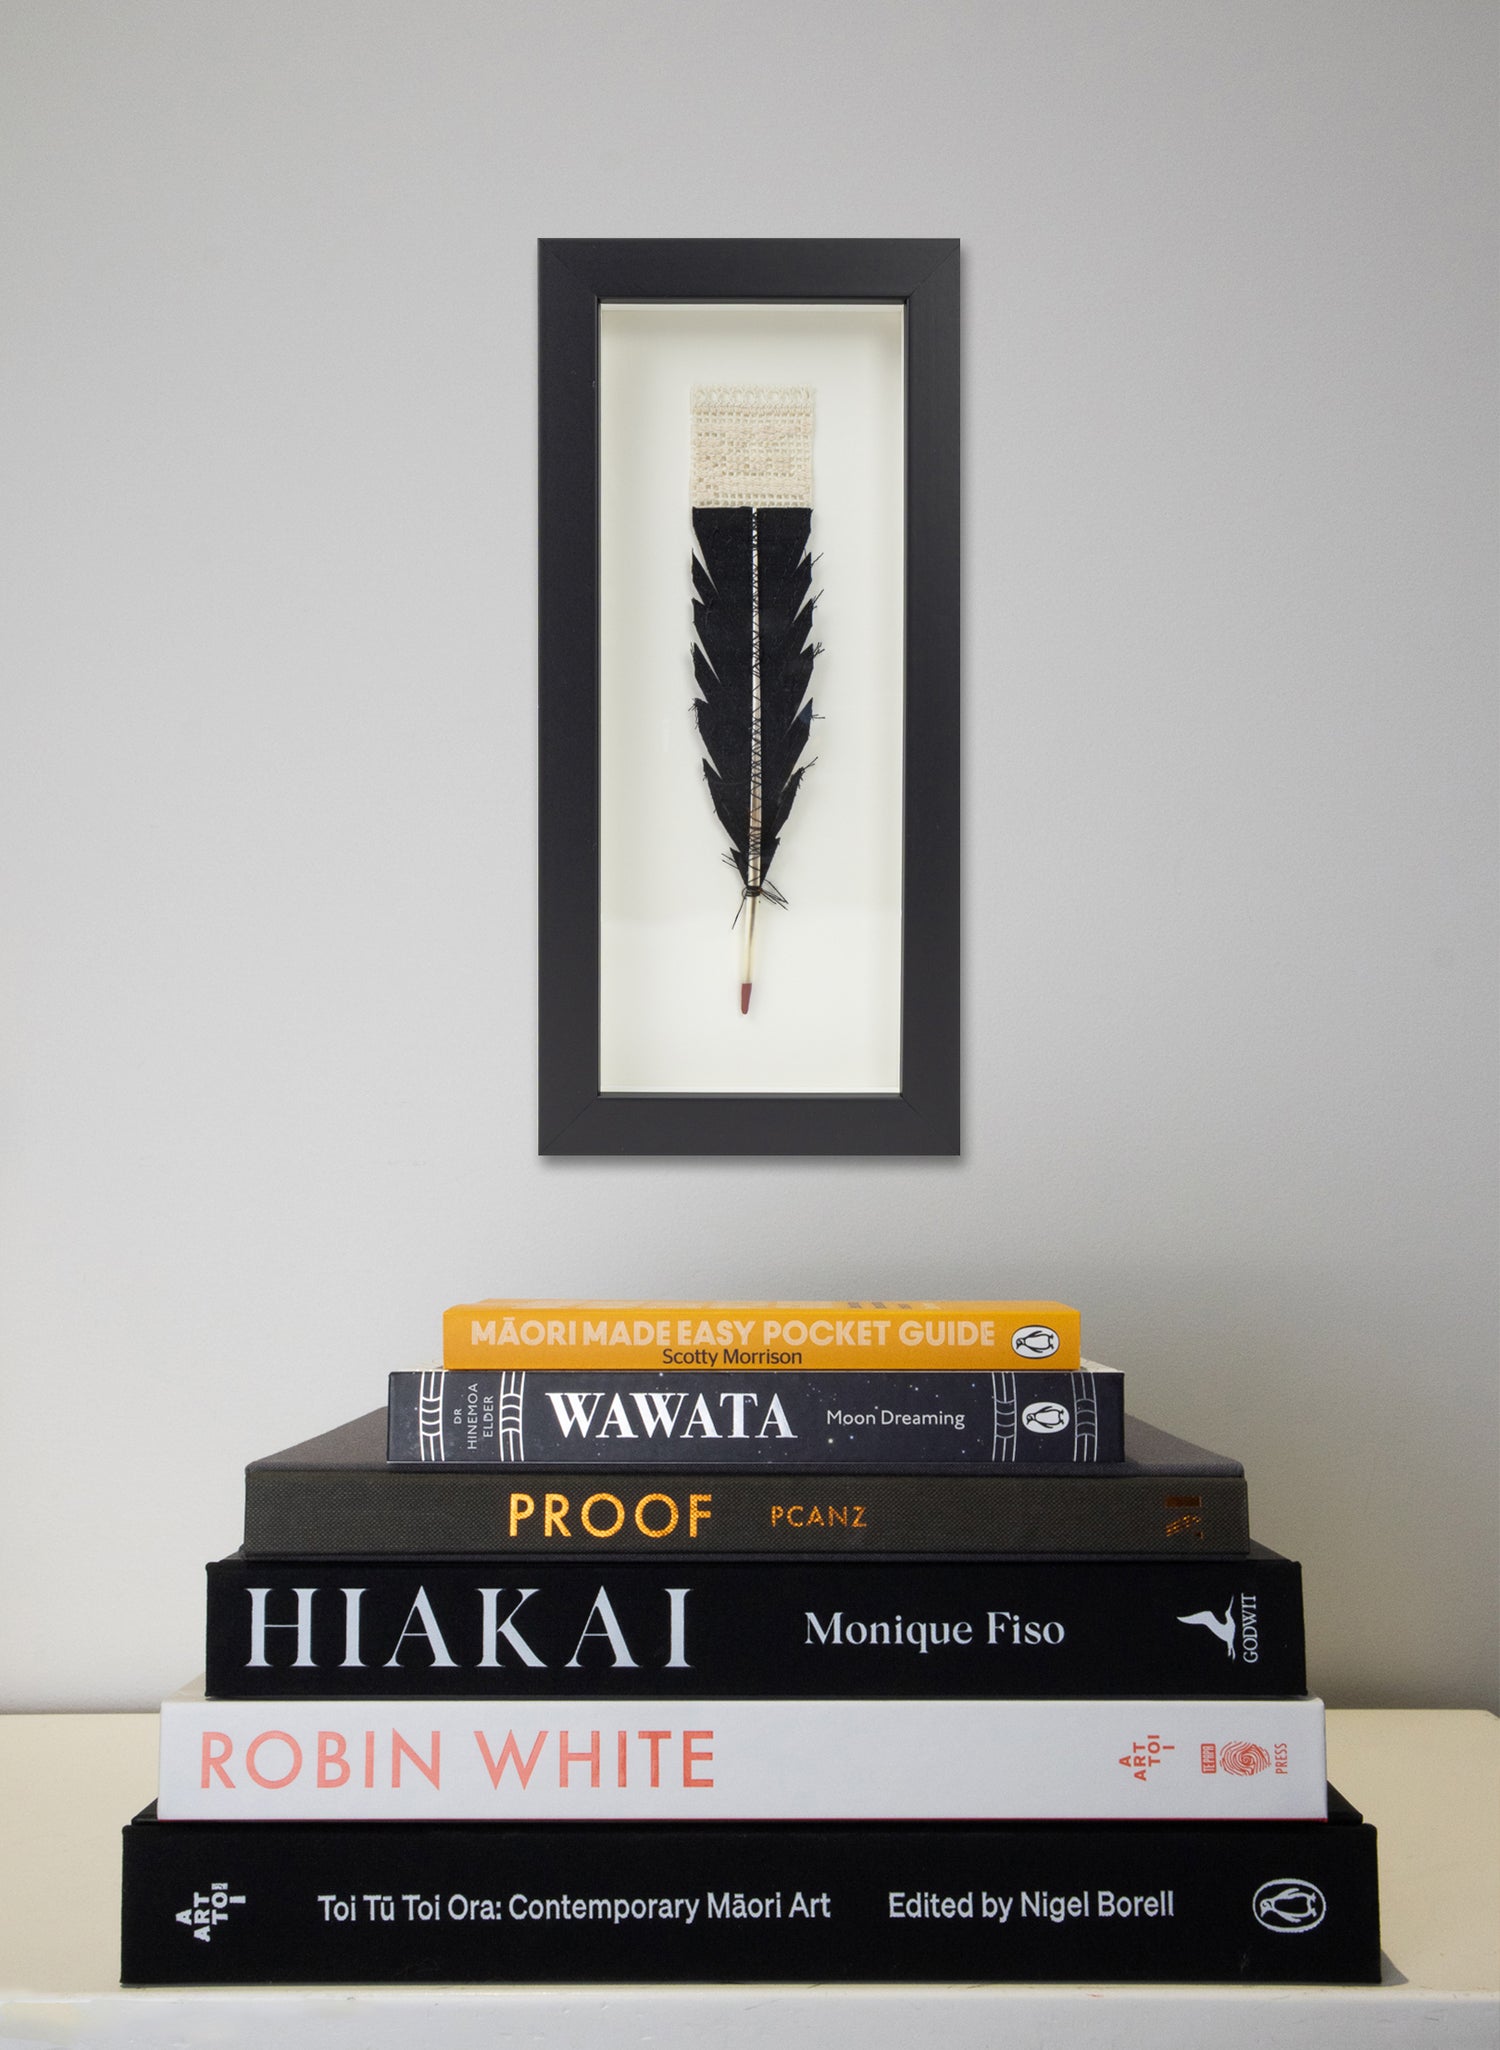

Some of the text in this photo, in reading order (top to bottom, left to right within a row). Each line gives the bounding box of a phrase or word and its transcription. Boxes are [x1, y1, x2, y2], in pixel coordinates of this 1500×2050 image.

[471, 1317, 996, 1347] MĀORI MADE EASY POCKET GUIDE
[662, 1348, 803, 1367] Scotty Morrison
[453, 1408, 462, 1424] DR
[467, 1382, 478, 1450] HINEMOA
[482, 1395, 494, 1438] ELDER
[545, 1392, 799, 1439] WAWATA
[825, 1407, 966, 1431] Moon Dreaming
[509, 1493, 712, 1537] PROOF
[771, 1505, 867, 1528] PCANZ
[243, 1585, 695, 1668] HIAKAI
[804, 1610, 1066, 1654] Monique Fiso
[1240, 1591, 1259, 1664] GODWIT
[201, 1728, 714, 1790] ROBIN WHITE
[1133, 1741, 1147, 1782] ART
[1147, 1734, 1161, 1767] TOI
[1273, 1742, 1289, 1775] PRESS
[193, 1891, 211, 1943] ART
[211, 1882, 229, 1926] TOI
[317, 1890, 832, 1925] Toi Tū Toi Ora: Contemporary Māori Art
[887, 1889, 1176, 1925] Edited by Nigel Borell
